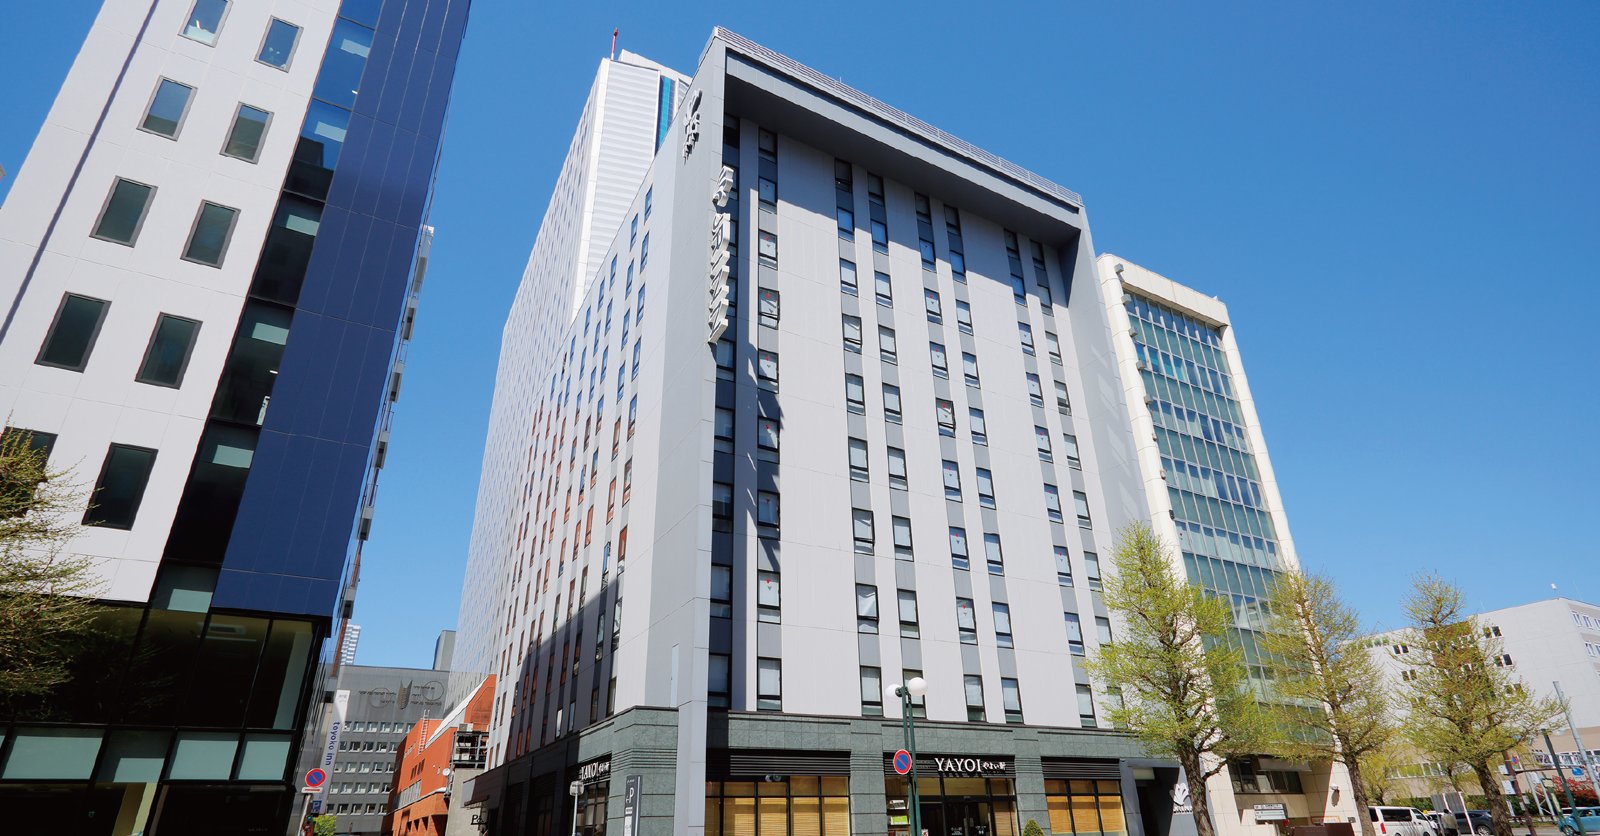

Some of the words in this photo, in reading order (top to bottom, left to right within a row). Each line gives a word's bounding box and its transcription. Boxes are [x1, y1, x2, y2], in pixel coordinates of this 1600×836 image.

[326, 721, 341, 751] toyoko
[325, 752, 335, 766] inn
[934, 757, 982, 772] YAYOI
